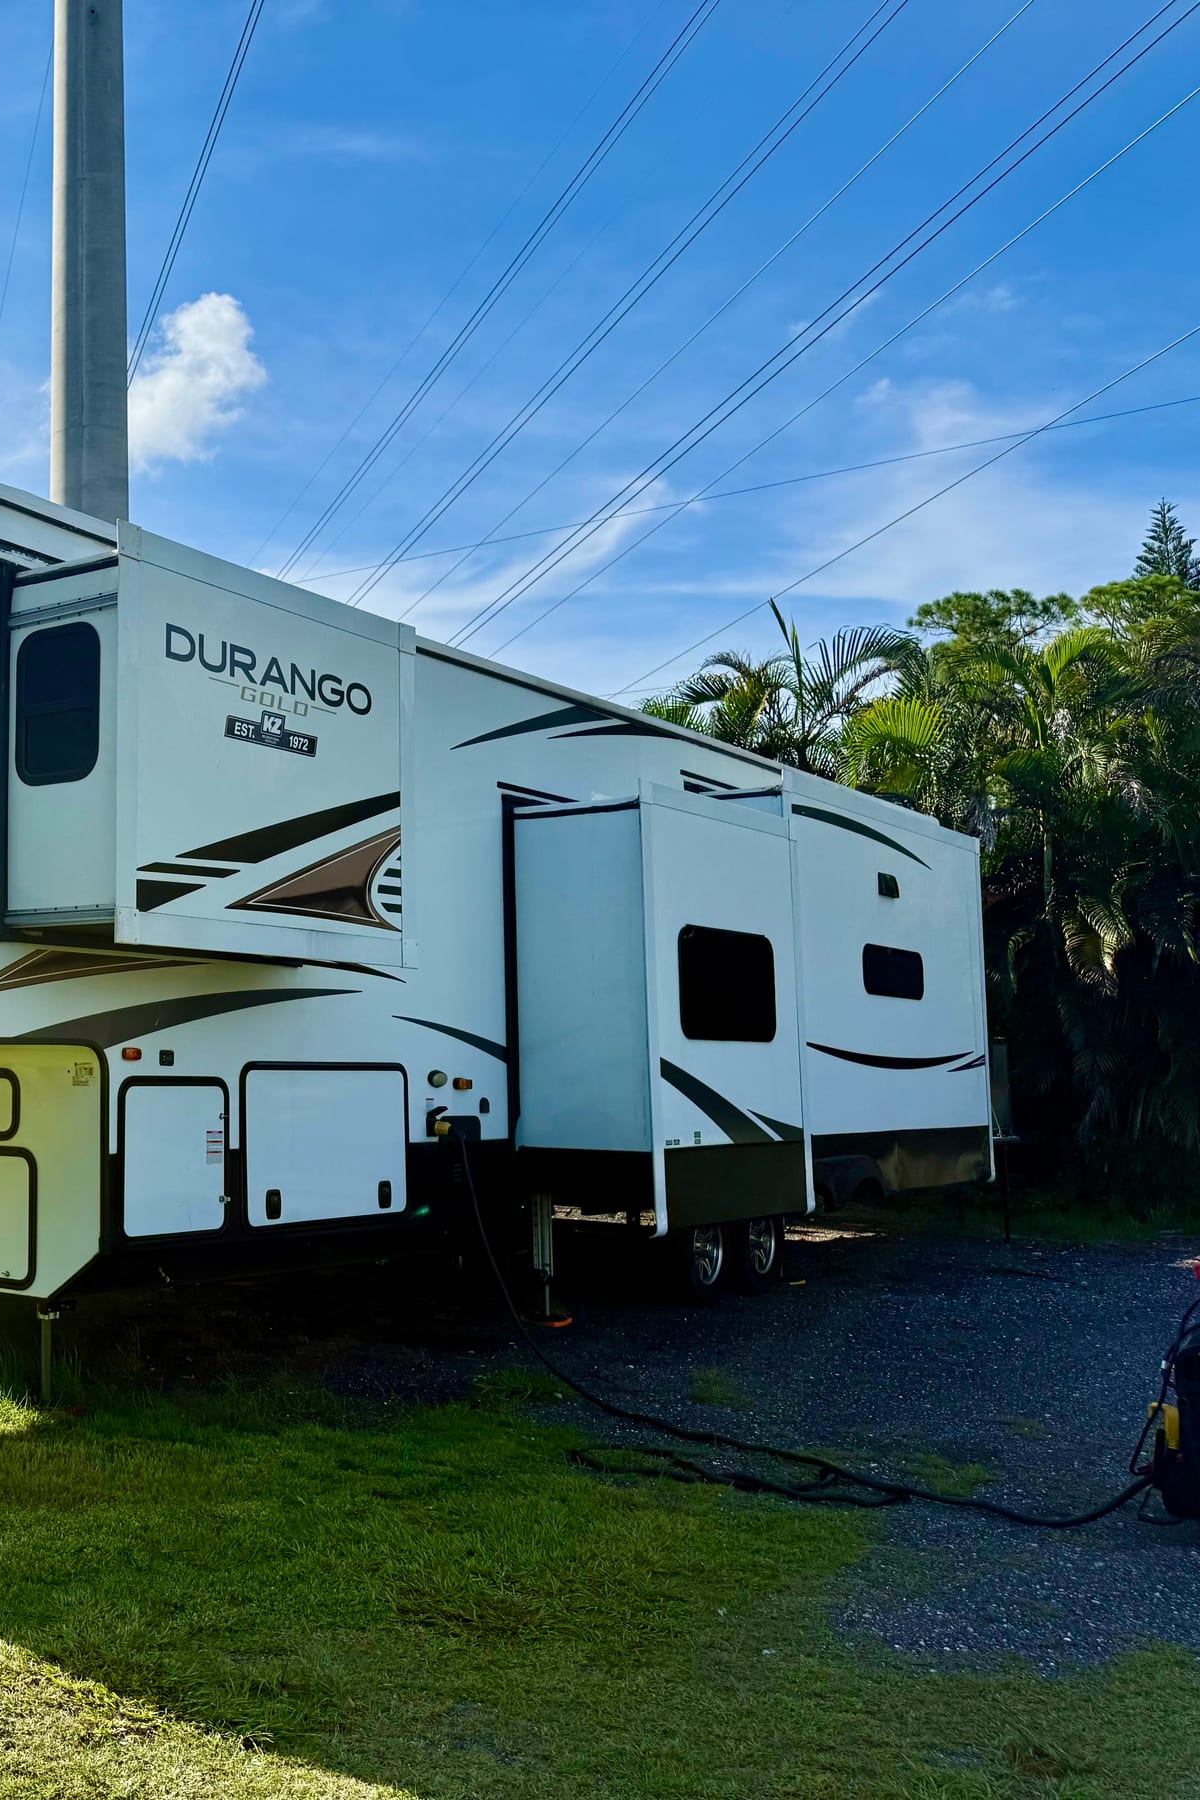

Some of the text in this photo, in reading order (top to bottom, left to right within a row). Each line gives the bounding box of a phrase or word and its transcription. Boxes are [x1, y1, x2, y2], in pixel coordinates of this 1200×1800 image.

[165, 622, 372, 716] DURANGO
[240, 686, 310, 717] GOLD
[234, 721, 256, 739] EST.
[262, 715, 283, 735] KZ
[288, 735, 309, 751] 1972
